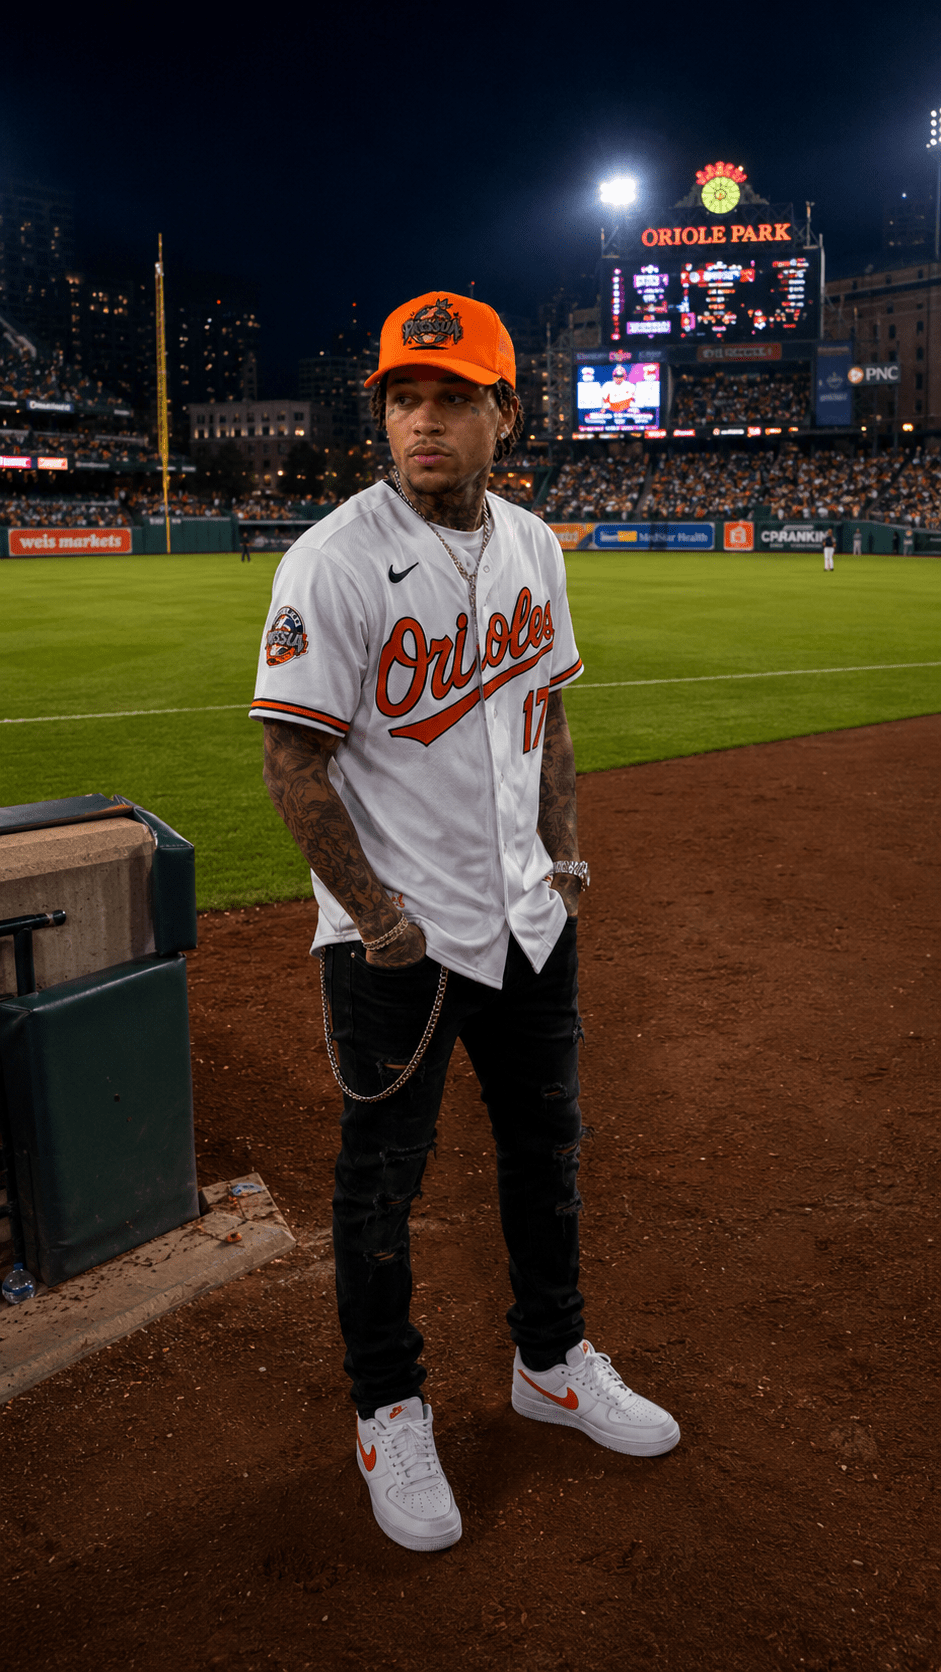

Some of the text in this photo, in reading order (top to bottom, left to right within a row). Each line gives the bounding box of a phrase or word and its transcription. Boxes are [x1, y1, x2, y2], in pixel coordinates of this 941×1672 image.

[641, 223, 792, 247] ORIOLE PARK
[865, 365, 900, 381] PNC
[19, 533, 122, 549] weis markets
[375, 587, 555, 718] Orioles
[522, 685, 550, 755] 17
